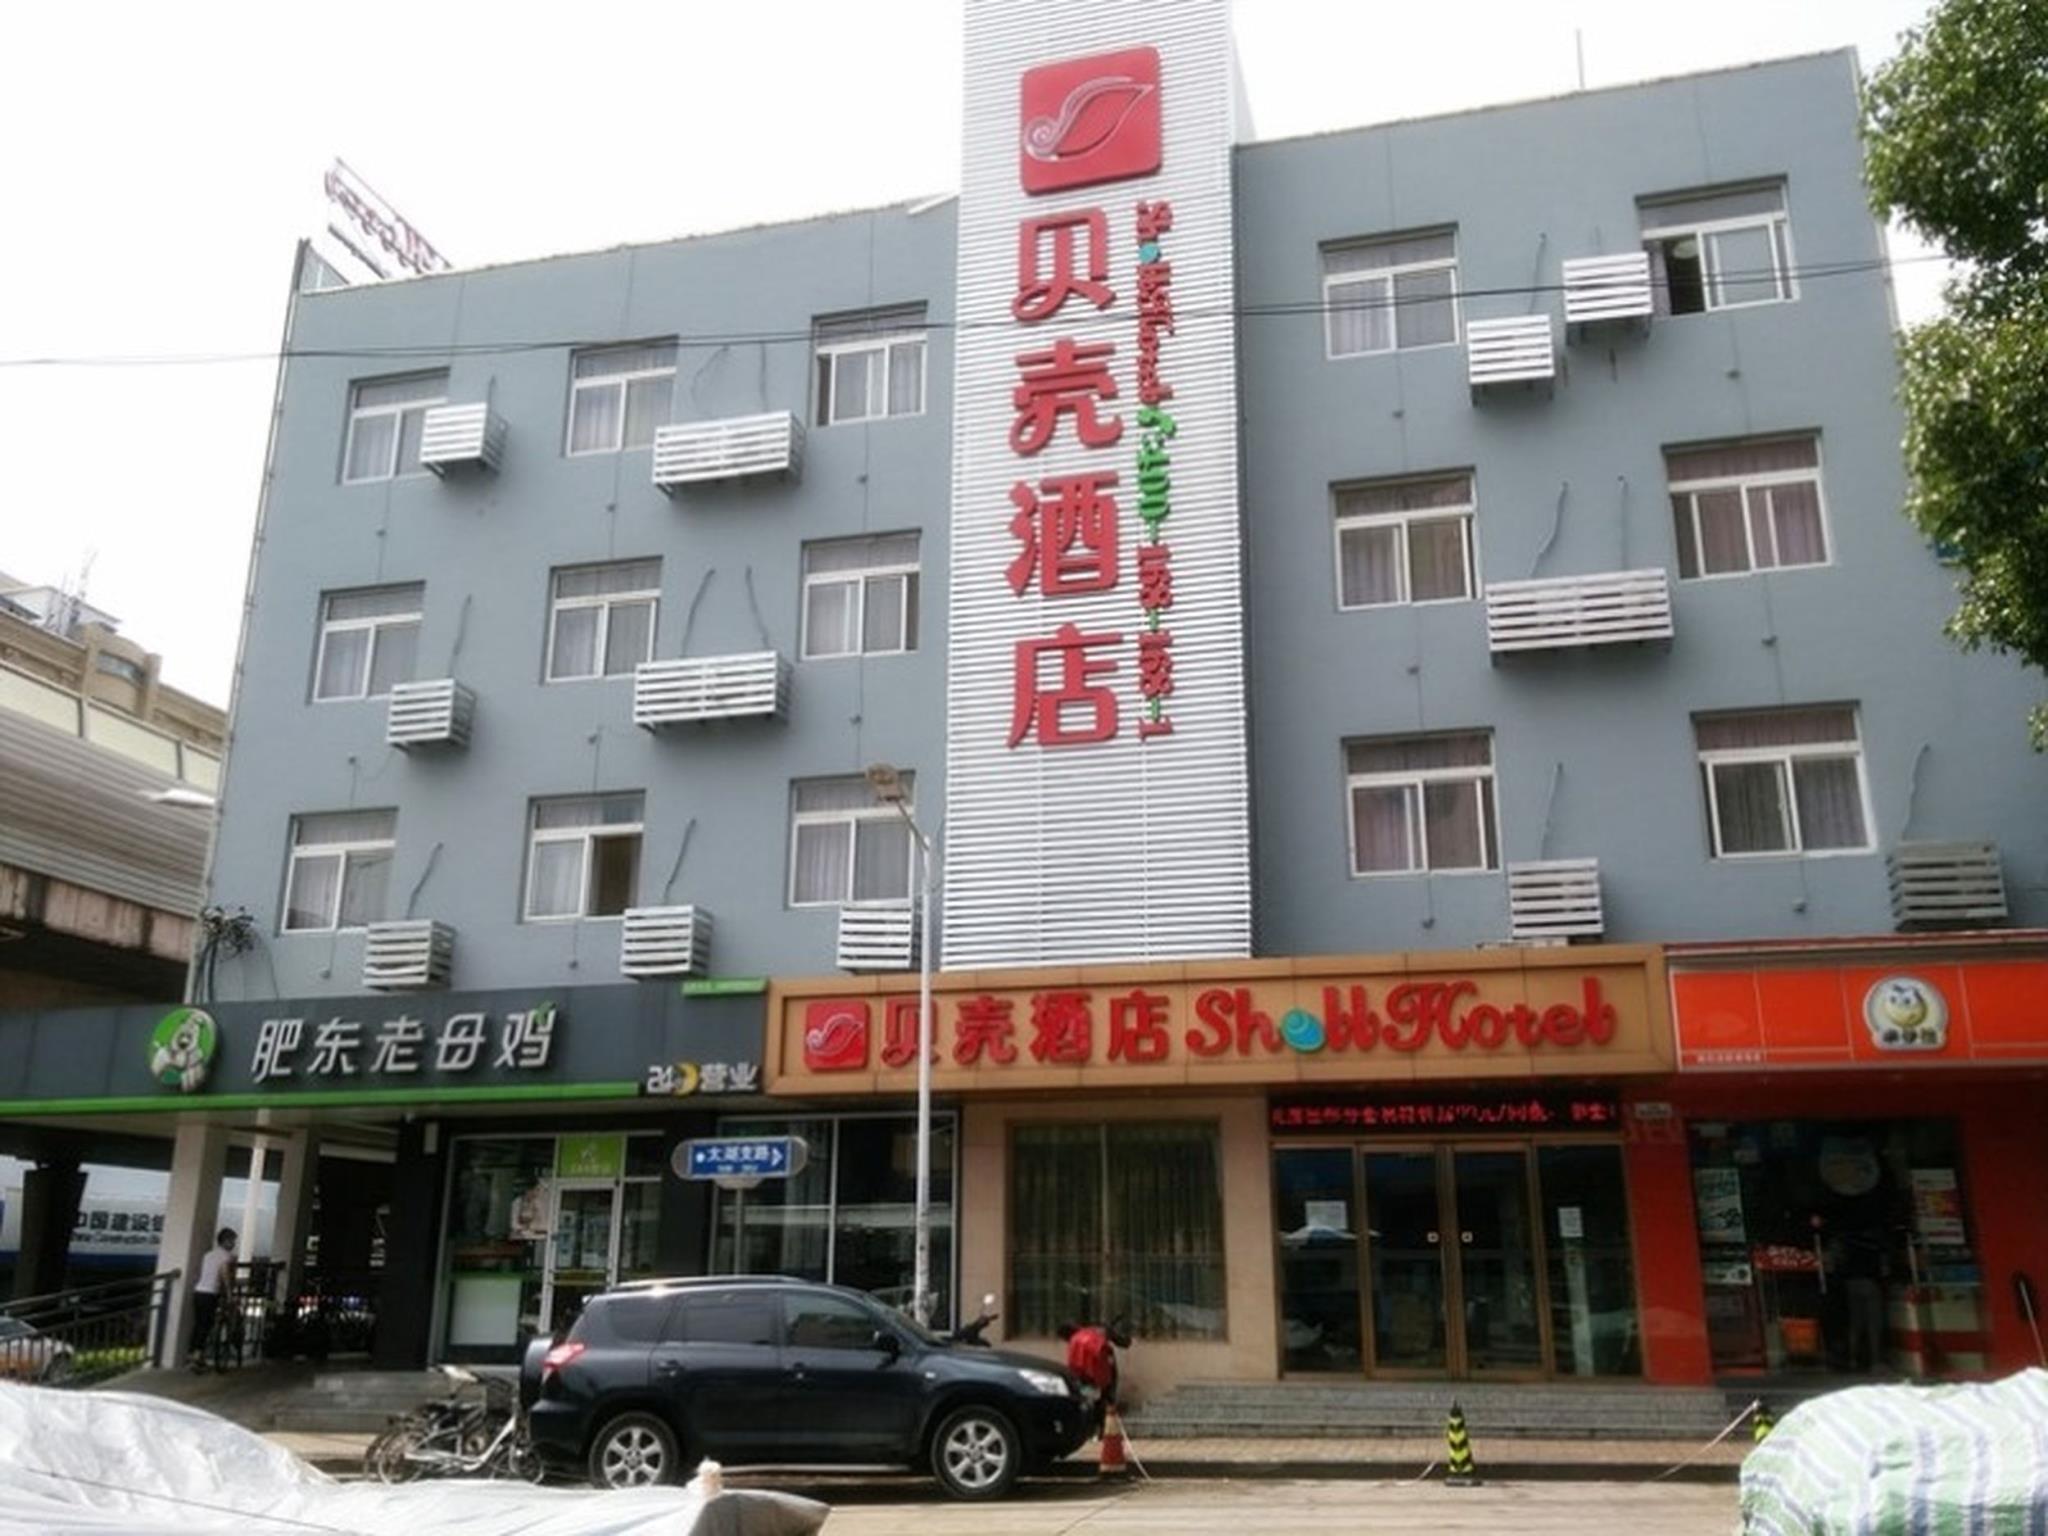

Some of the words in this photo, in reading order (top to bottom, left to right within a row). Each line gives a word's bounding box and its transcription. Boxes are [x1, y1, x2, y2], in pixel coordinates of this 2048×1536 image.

[1006, 206, 1124, 750] 贝壳酒店
[250, 1008, 557, 1084] 肥东老母鸡
[881, 988, 1171, 1067] 贝壳酒店
